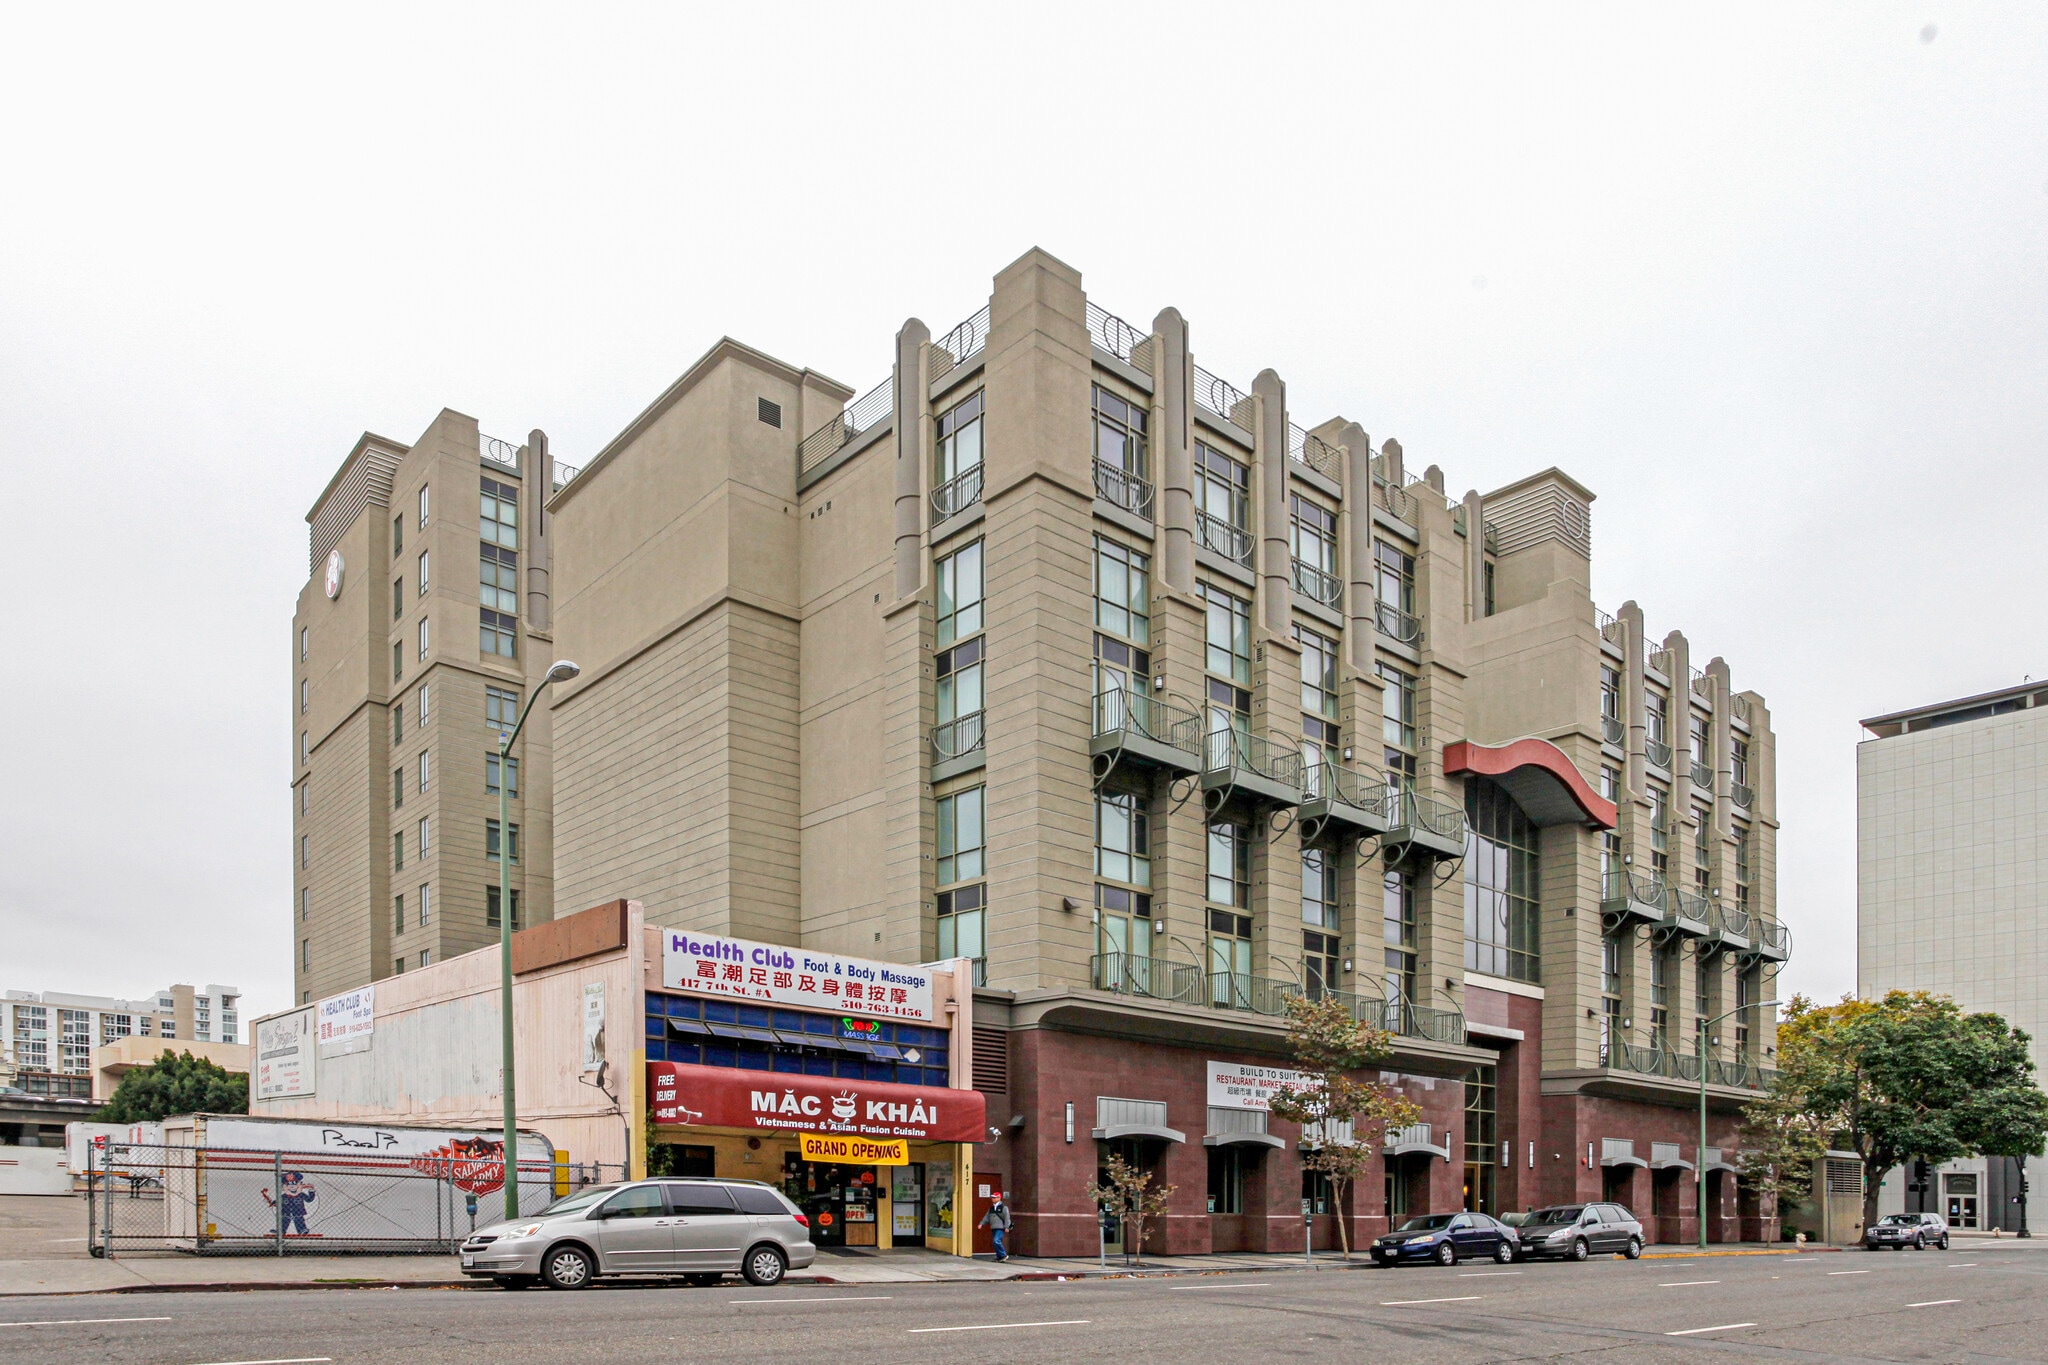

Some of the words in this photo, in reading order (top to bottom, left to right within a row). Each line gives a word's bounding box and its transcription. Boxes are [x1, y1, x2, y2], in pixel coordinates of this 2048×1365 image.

[672, 934, 744, 962] Health
[752, 948, 795, 970] Club
[695, 959, 908, 1005] 富潮足部及身體按摩
[804, 958, 829, 973] Foot
[834, 962, 842, 975] &
[848, 964, 876, 982] Body
[881, 969, 926, 989] Massage
[678, 978, 701, 989] 417
[706, 981, 728, 991] 7th
[733, 985, 751, 996] St.
[755, 988, 772, 998] #A
[326, 999, 345, 1017] HEALTH
[346, 994, 360, 1011] CLUB
[353, 1010, 363, 1019] Foot
[363, 1007, 371, 1018] Spa
[841, 999, 923, 1018] 510-763-1456
[657, 1074, 675, 1087] FREE
[1240, 1067, 1264, 1078] BUILD
[1267, 1069, 1277, 1079] TO
[1280, 1071, 1297, 1081] SUIT
[656, 1090, 677, 1102] DELIVERY
[1243, 1098, 1254, 1106] Call
[751, 1088, 822, 1117] MẶC
[866, 1098, 937, 1125] KHẢI
[755, 1117, 816, 1130] Vietnamese
[819, 1121, 827, 1130] &
[830, 1122, 857, 1132] Asian
[860, 1124, 890, 1135] Fusion
[893, 1127, 926, 1137] Cuisine
[806, 1139, 847, 1156] GRAND
[852, 1143, 901, 1159] OPENING
[472, 1163, 500, 1190] ARMY
[845, 1210, 865, 1220] OPEN
